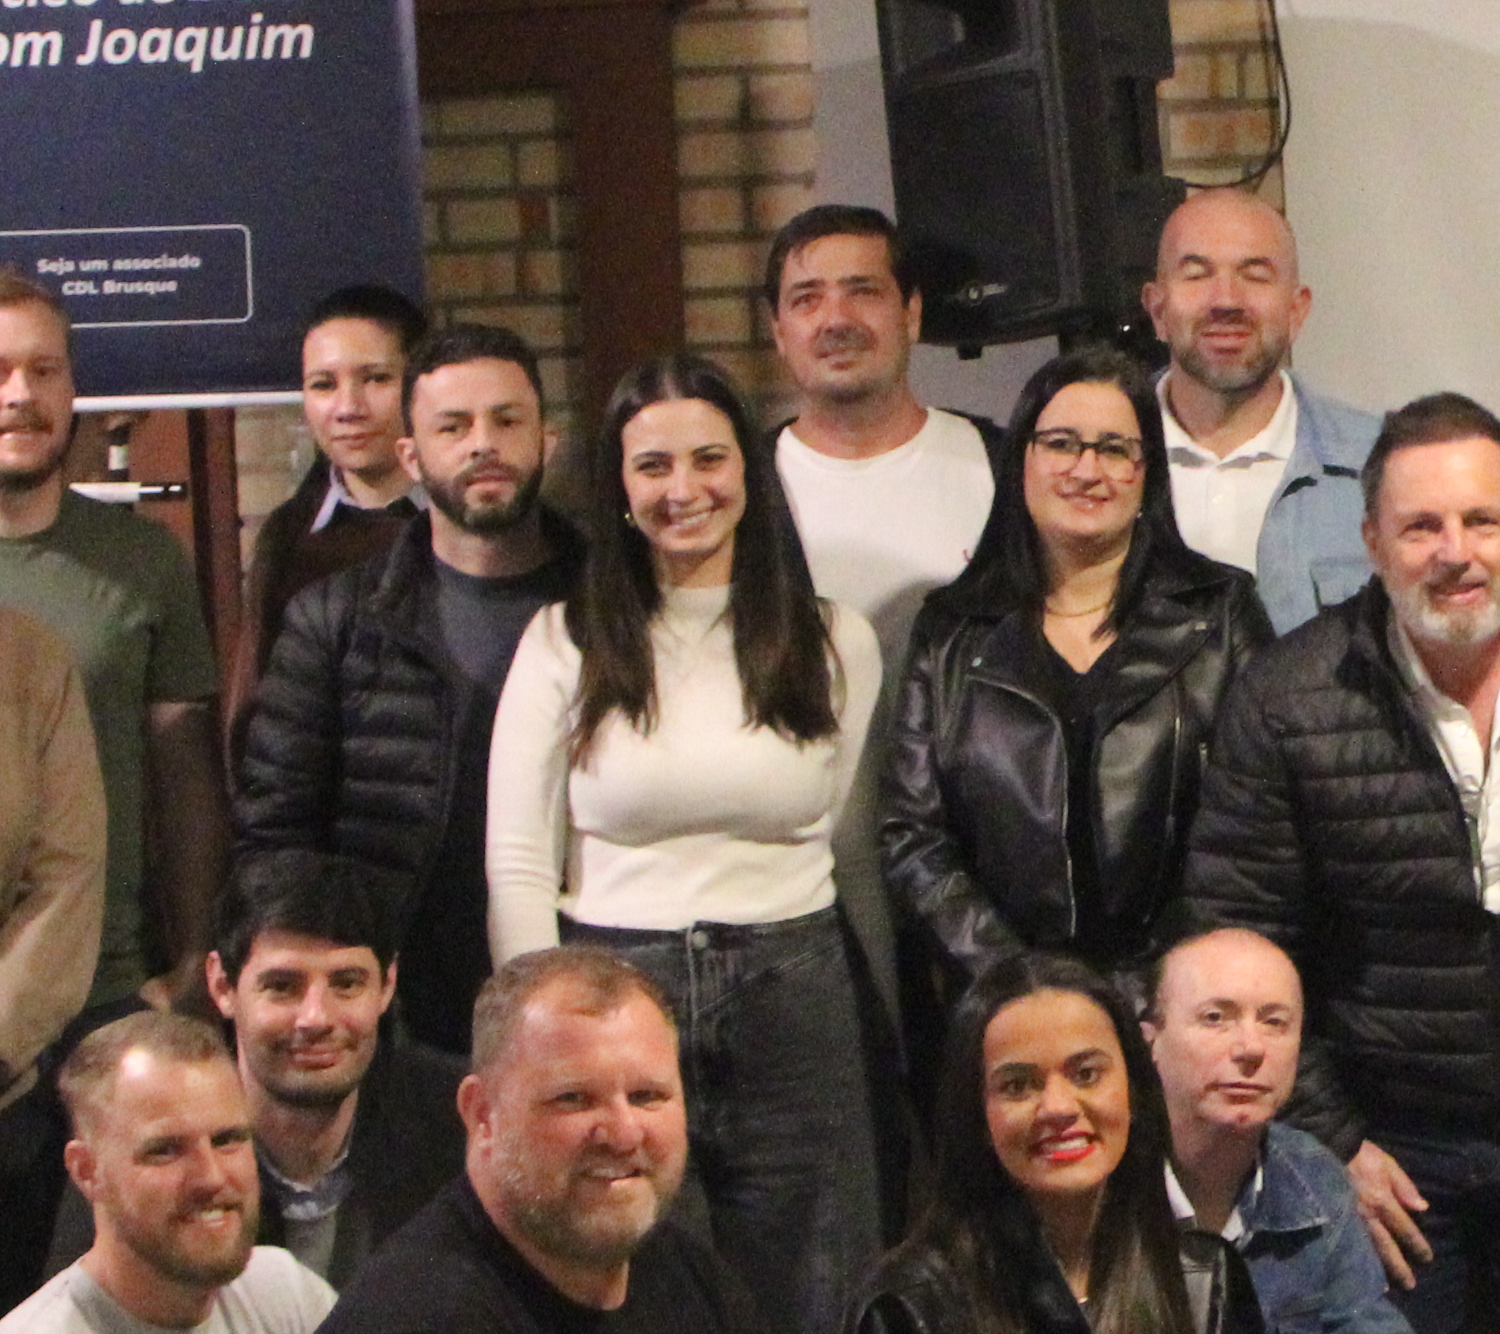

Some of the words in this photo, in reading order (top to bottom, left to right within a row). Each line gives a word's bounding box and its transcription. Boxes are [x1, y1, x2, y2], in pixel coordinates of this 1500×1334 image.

[75, 12, 315, 74] Joaquim
[36, 257, 75, 276] Seja
[79, 259, 109, 272] um
[112, 253, 202, 271] associado
[61, 280, 99, 295] CDL
[103, 279, 178, 296] Brusque
